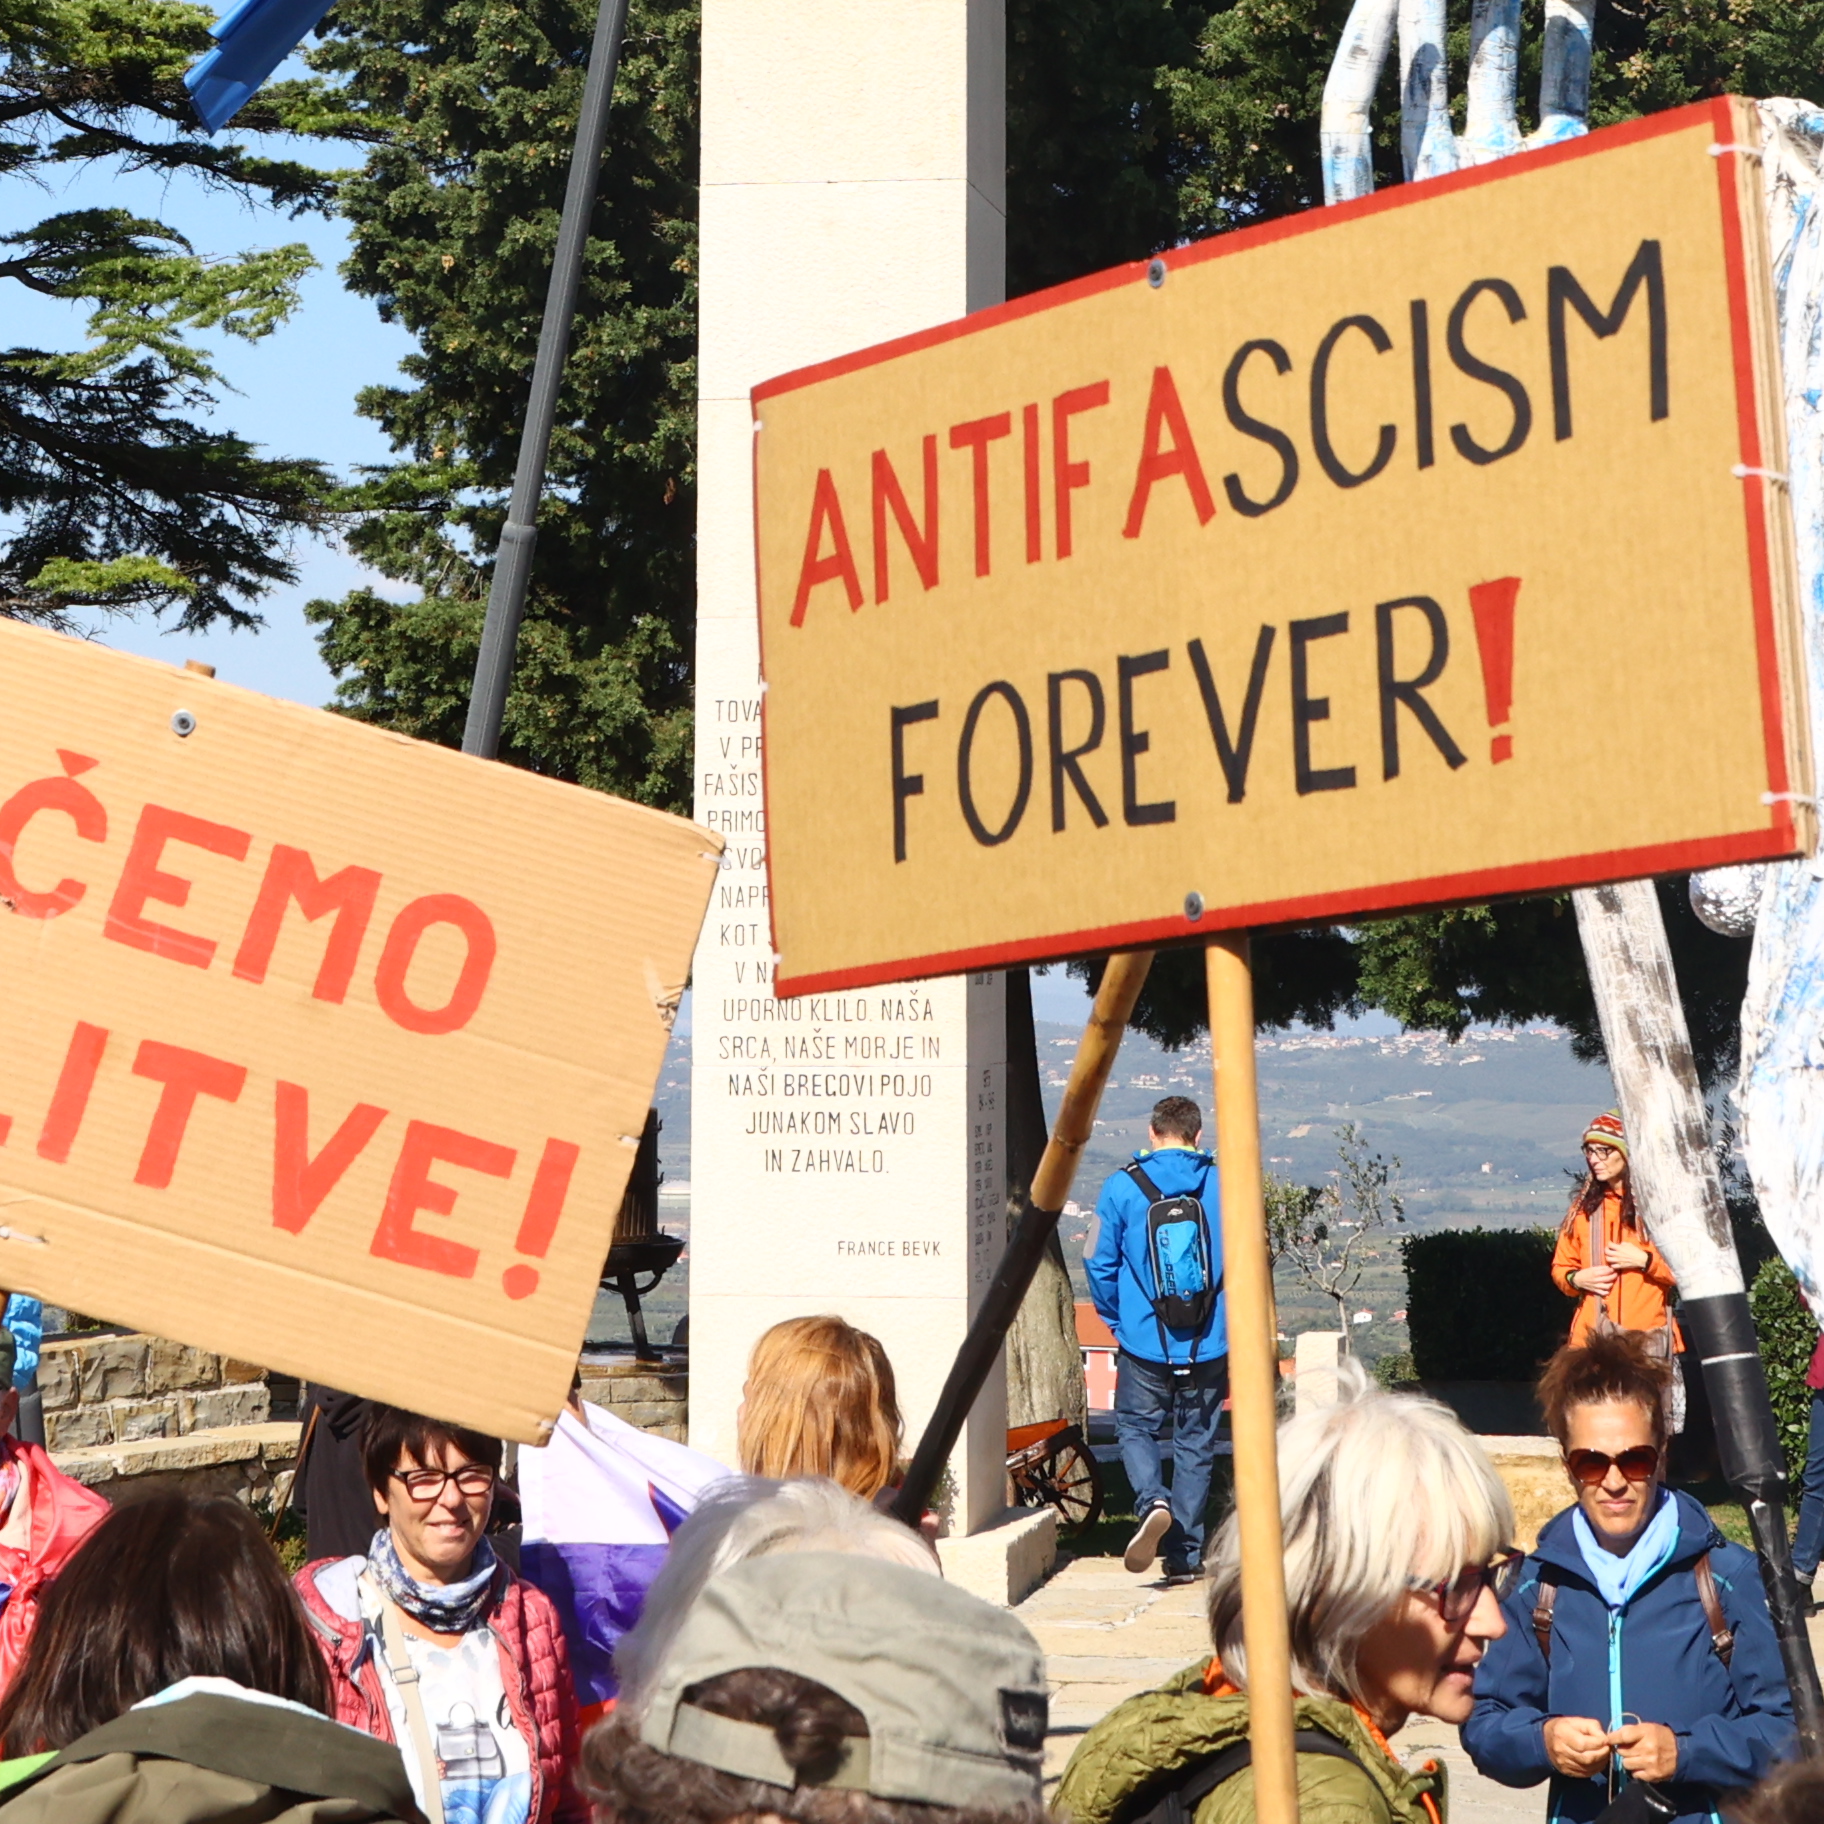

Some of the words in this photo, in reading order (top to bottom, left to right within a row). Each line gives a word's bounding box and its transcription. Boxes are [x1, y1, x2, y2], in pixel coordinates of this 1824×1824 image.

[790, 239, 1669, 629] ANTIFASCISM
[890, 576, 1521, 864] FOREVER!
[719, 736, 732, 760] V
[720, 923, 759, 947] KOT
[735, 961, 746, 984] V
[723, 998, 802, 1022] UPORNO
[881, 989, 934, 1022] NAŠA
[719, 1035, 777, 1064] SRCA,
[784, 1027, 836, 1060] NAŠE
[845, 1036, 914, 1060] MORJE
[921, 1036, 940, 1060] IN
[728, 1066, 775, 1097] NAŠI
[783, 1074, 874, 1097] BREGOVI
[880, 1074, 933, 1098] POJO
[745, 1111, 842, 1135] JUNAKOM
[850, 1111, 915, 1136] SLAVO
[764, 1149, 783, 1173] IN
[790, 1149, 890, 1174] ZAHVALO.
[837, 1240, 896, 1257] FRANCE
[901, 1240, 942, 1257] BEVK
